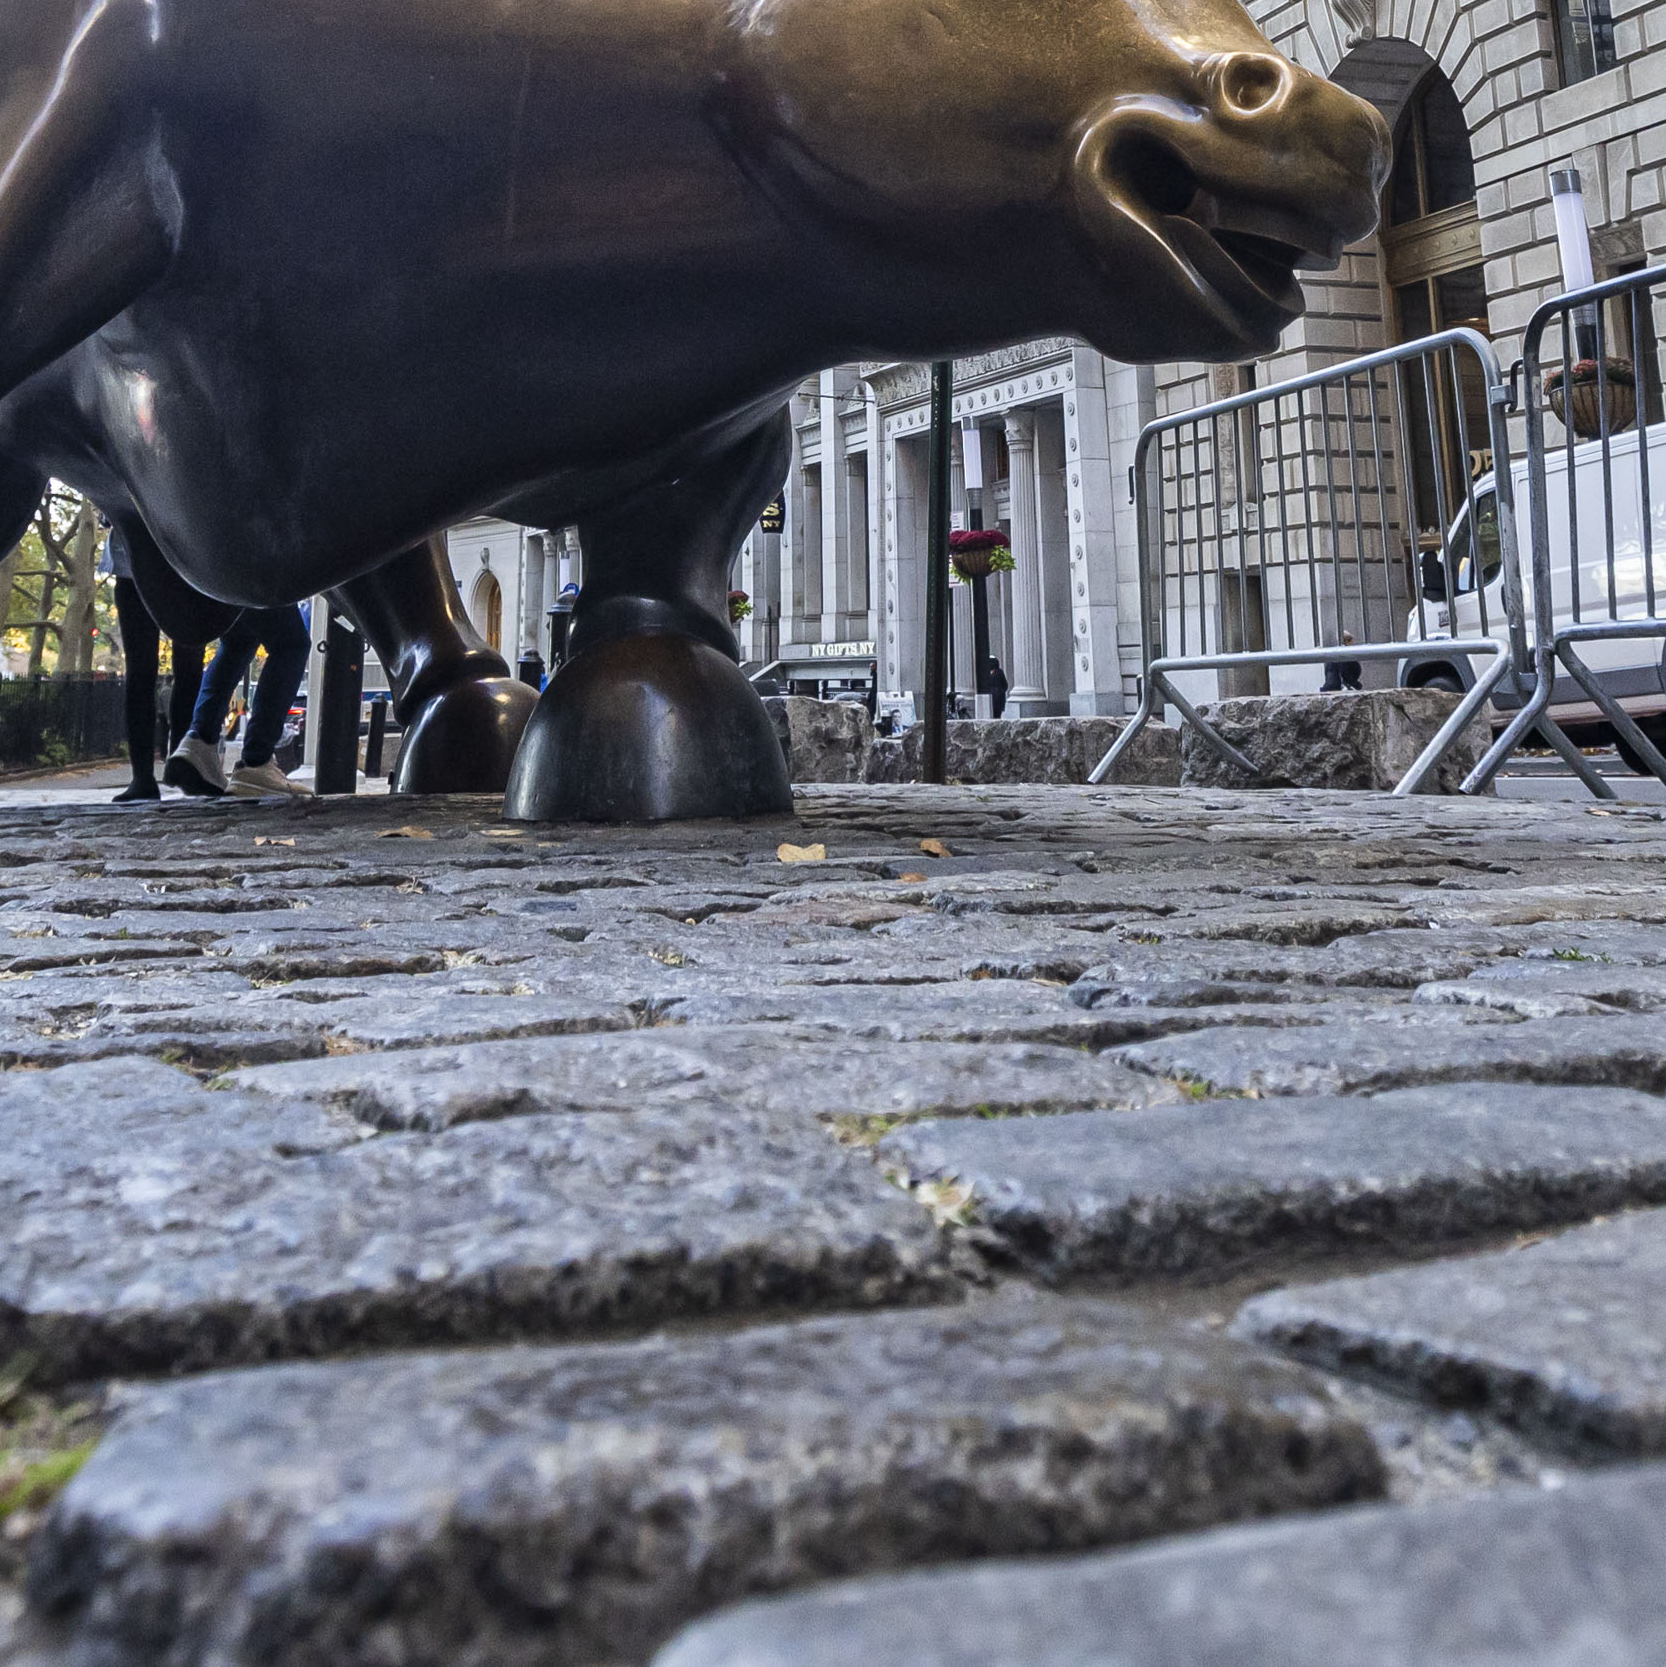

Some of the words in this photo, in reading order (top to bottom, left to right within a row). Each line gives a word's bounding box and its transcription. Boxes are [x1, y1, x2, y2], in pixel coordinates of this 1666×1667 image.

[763, 520, 780, 528] NY
[812, 644, 826, 656] NY
[827, 643, 857, 656] GIFTS
[859, 642, 875, 655] NY
